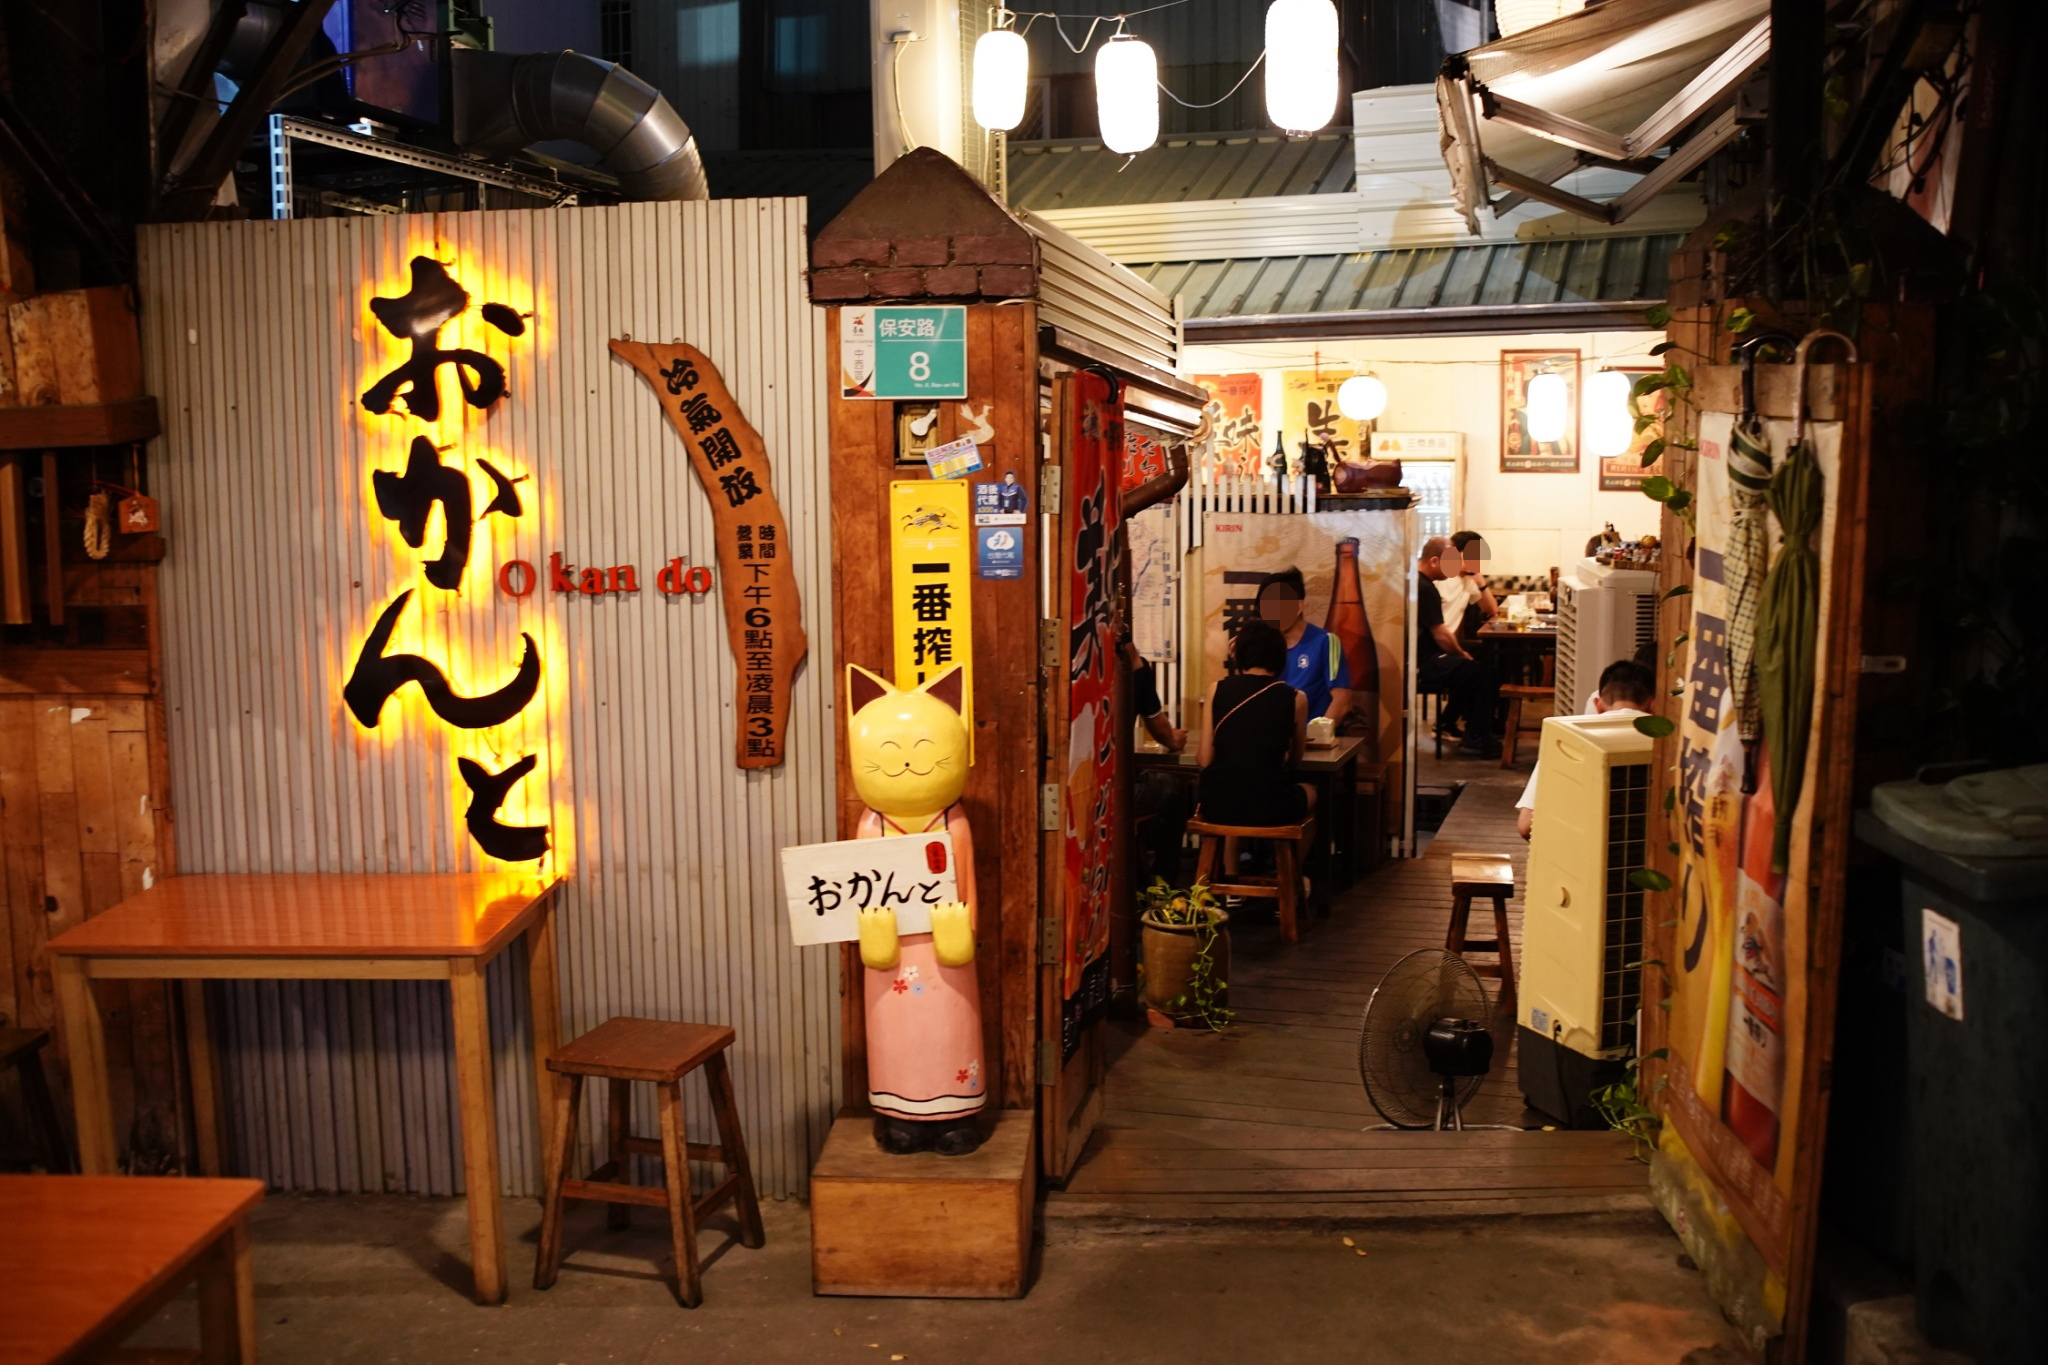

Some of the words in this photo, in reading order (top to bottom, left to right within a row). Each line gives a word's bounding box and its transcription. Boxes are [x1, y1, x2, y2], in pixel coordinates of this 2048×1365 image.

[879, 318, 935, 338] 保安路
[909, 351, 931, 382] 8
[659, 358, 761, 508] 冷氣開放
[737, 525, 753, 559] 營業
[758, 525, 775, 559] 時間
[1215, 524, 1243, 533] KIRIN
[344, 255, 550, 862] おかんと
[498, 559, 537, 597] O
[549, 551, 640, 595] kan
[657, 555, 713, 594] do
[912, 562, 952, 685] 一番搾
[743, 563, 775, 758] 下午6點至凌晨3點
[808, 869, 943, 916] おかんと
